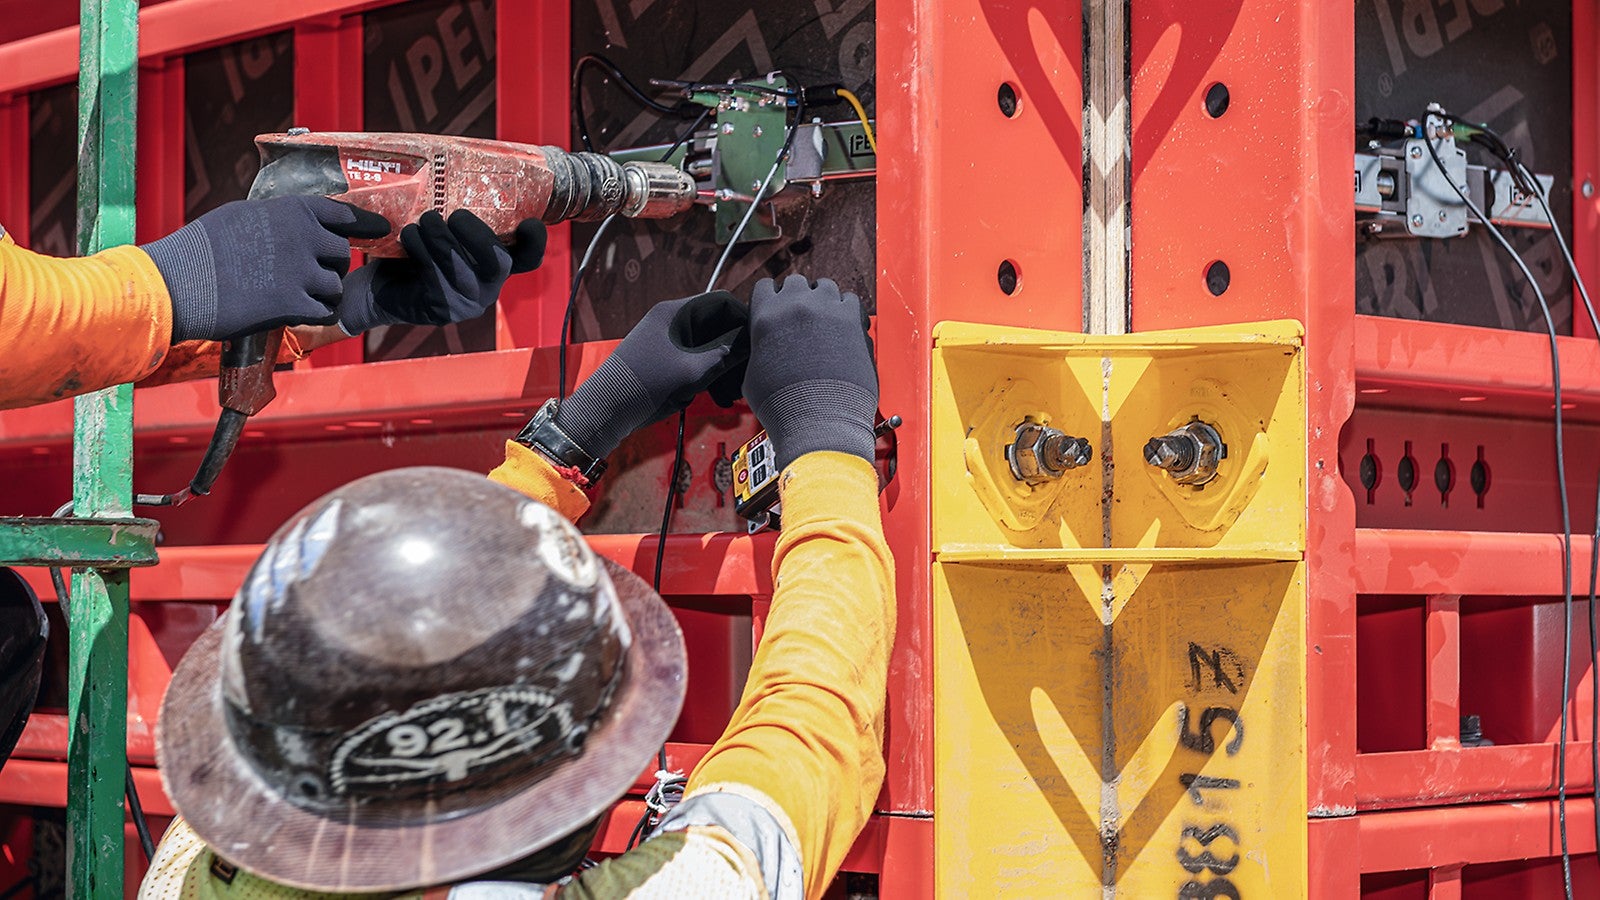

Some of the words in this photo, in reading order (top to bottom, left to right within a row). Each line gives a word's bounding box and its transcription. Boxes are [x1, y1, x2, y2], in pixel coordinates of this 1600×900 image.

[347, 159, 401, 174] HILTI
[347, 171, 362, 180] TE
[386, 698, 508, 757] 92.1
